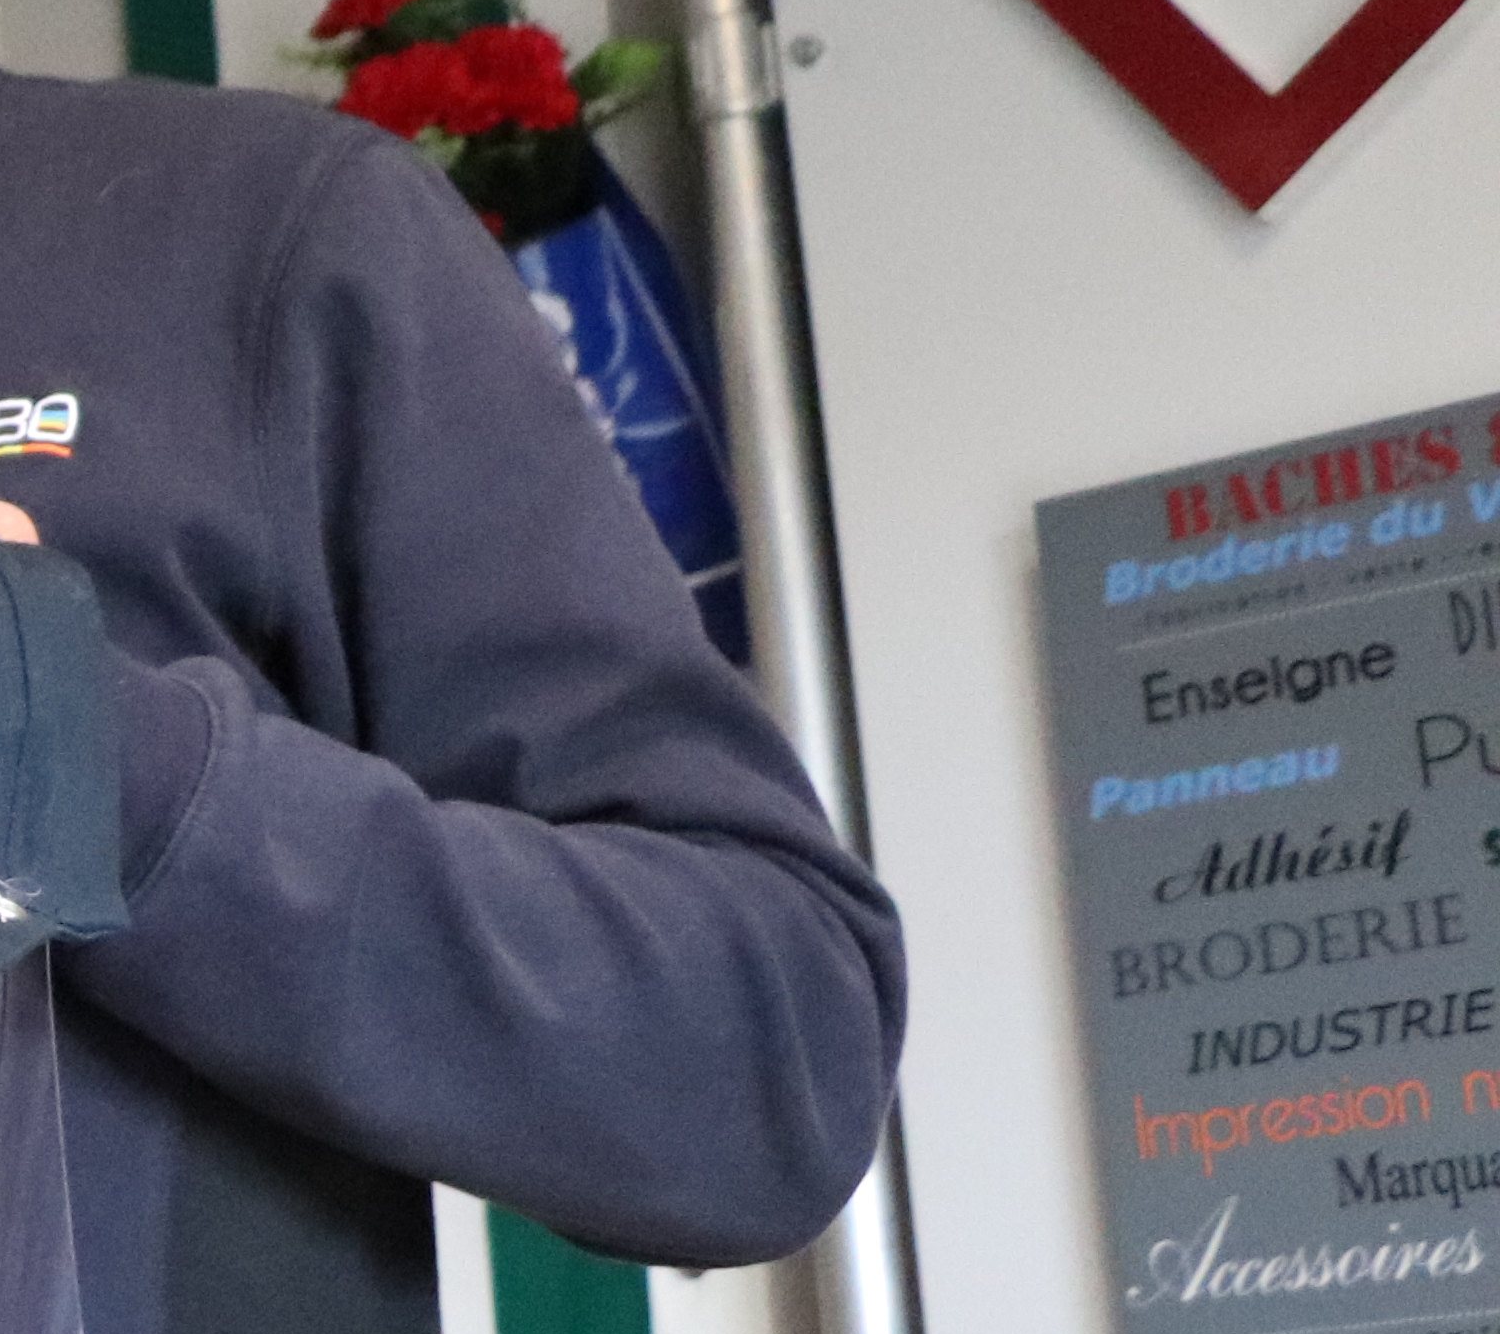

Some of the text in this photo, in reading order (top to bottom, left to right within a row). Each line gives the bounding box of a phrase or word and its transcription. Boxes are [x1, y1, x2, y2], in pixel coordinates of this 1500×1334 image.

[1165, 428, 1462, 541] BACHES
[1104, 521, 1353, 605] Broderie
[1367, 500, 1447, 547] du
[1141, 641, 1396, 725] Enseigne
[1090, 745, 1342, 820] Panneau
[1154, 808, 1411, 904] Adhésif
[1110, 892, 1468, 1000] BRODERIE
[1188, 986, 1495, 1075] INDUSTRIE
[1134, 1074, 1432, 1177] Impression
[1126, 1194, 1487, 1309] Accessoires
